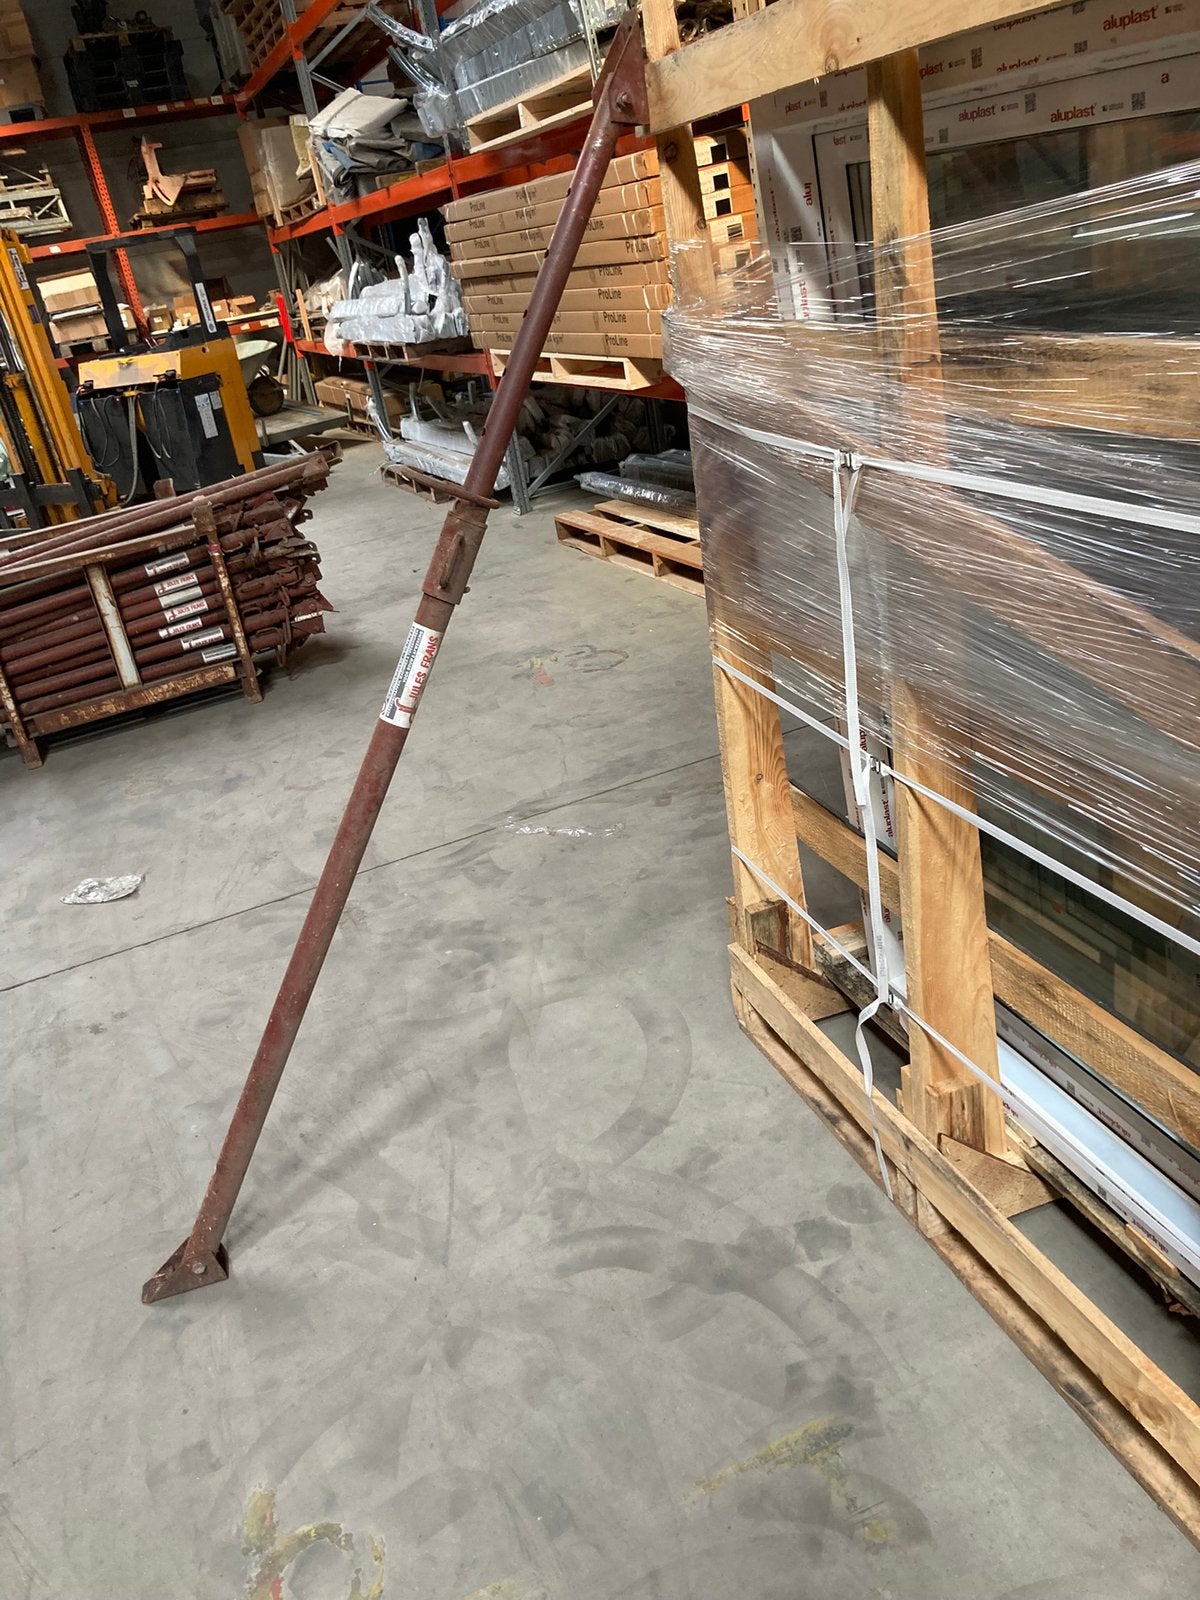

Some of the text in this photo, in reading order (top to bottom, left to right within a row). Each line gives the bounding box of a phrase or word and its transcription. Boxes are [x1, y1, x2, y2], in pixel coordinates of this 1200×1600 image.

[1103, 6, 1158, 31] aluplast
[958, 103, 997, 122] aluplast
[1050, 103, 1097, 123] aluplast
[599, 265, 622, 277] ProLine
[598, 288, 622, 300] ProLine
[603, 311, 627, 323] ProLine
[605, 335, 628, 347] ProLine
[408, 635, 440, 702] JULES FRANS
[883, 800, 894, 838] aluplast
